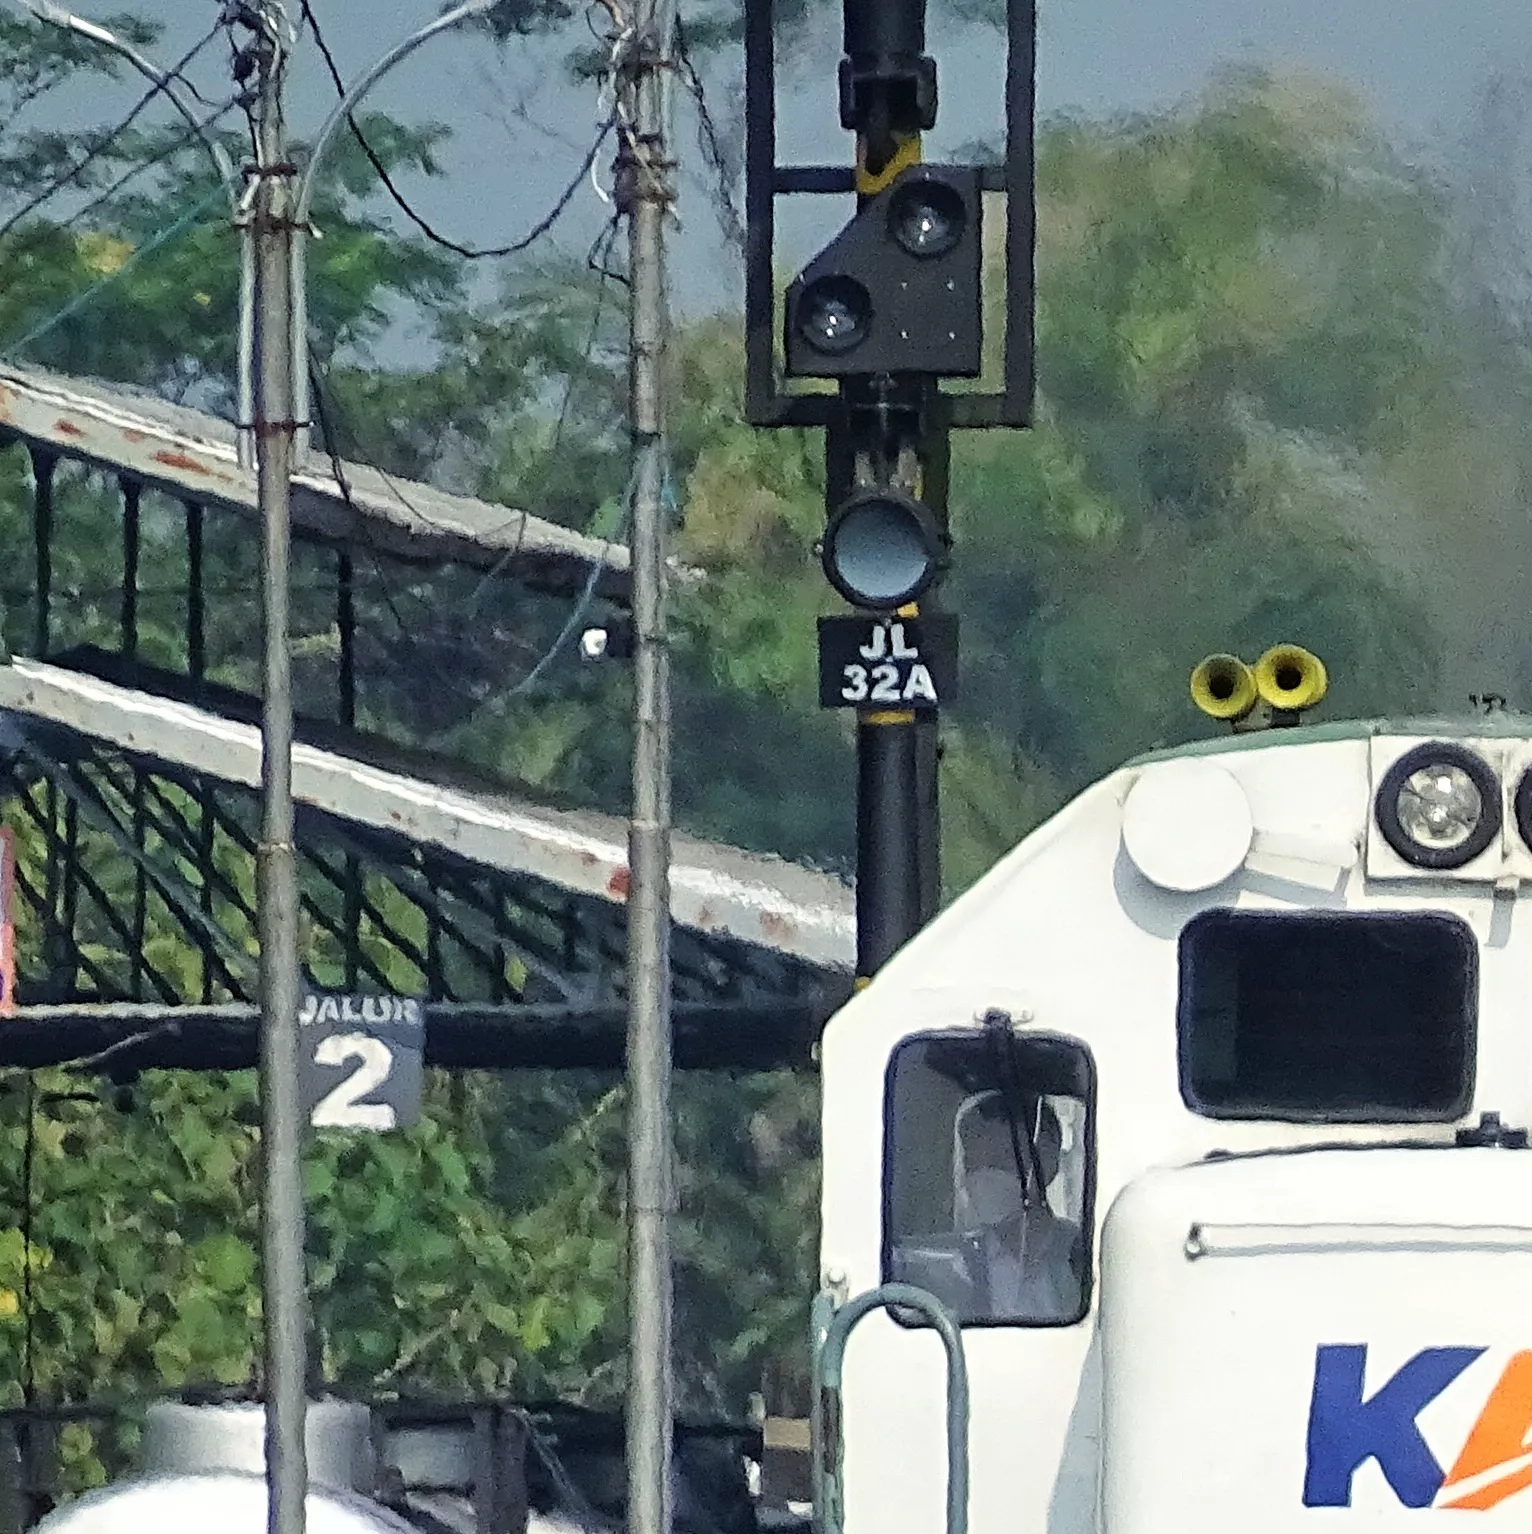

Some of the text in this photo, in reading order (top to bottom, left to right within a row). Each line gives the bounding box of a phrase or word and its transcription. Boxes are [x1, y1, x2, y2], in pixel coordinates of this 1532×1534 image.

[859, 622, 919, 660] JL
[841, 663, 938, 702] 32A
[299, 994, 420, 1025] JALUR
[310, 1031, 397, 1130] 2
